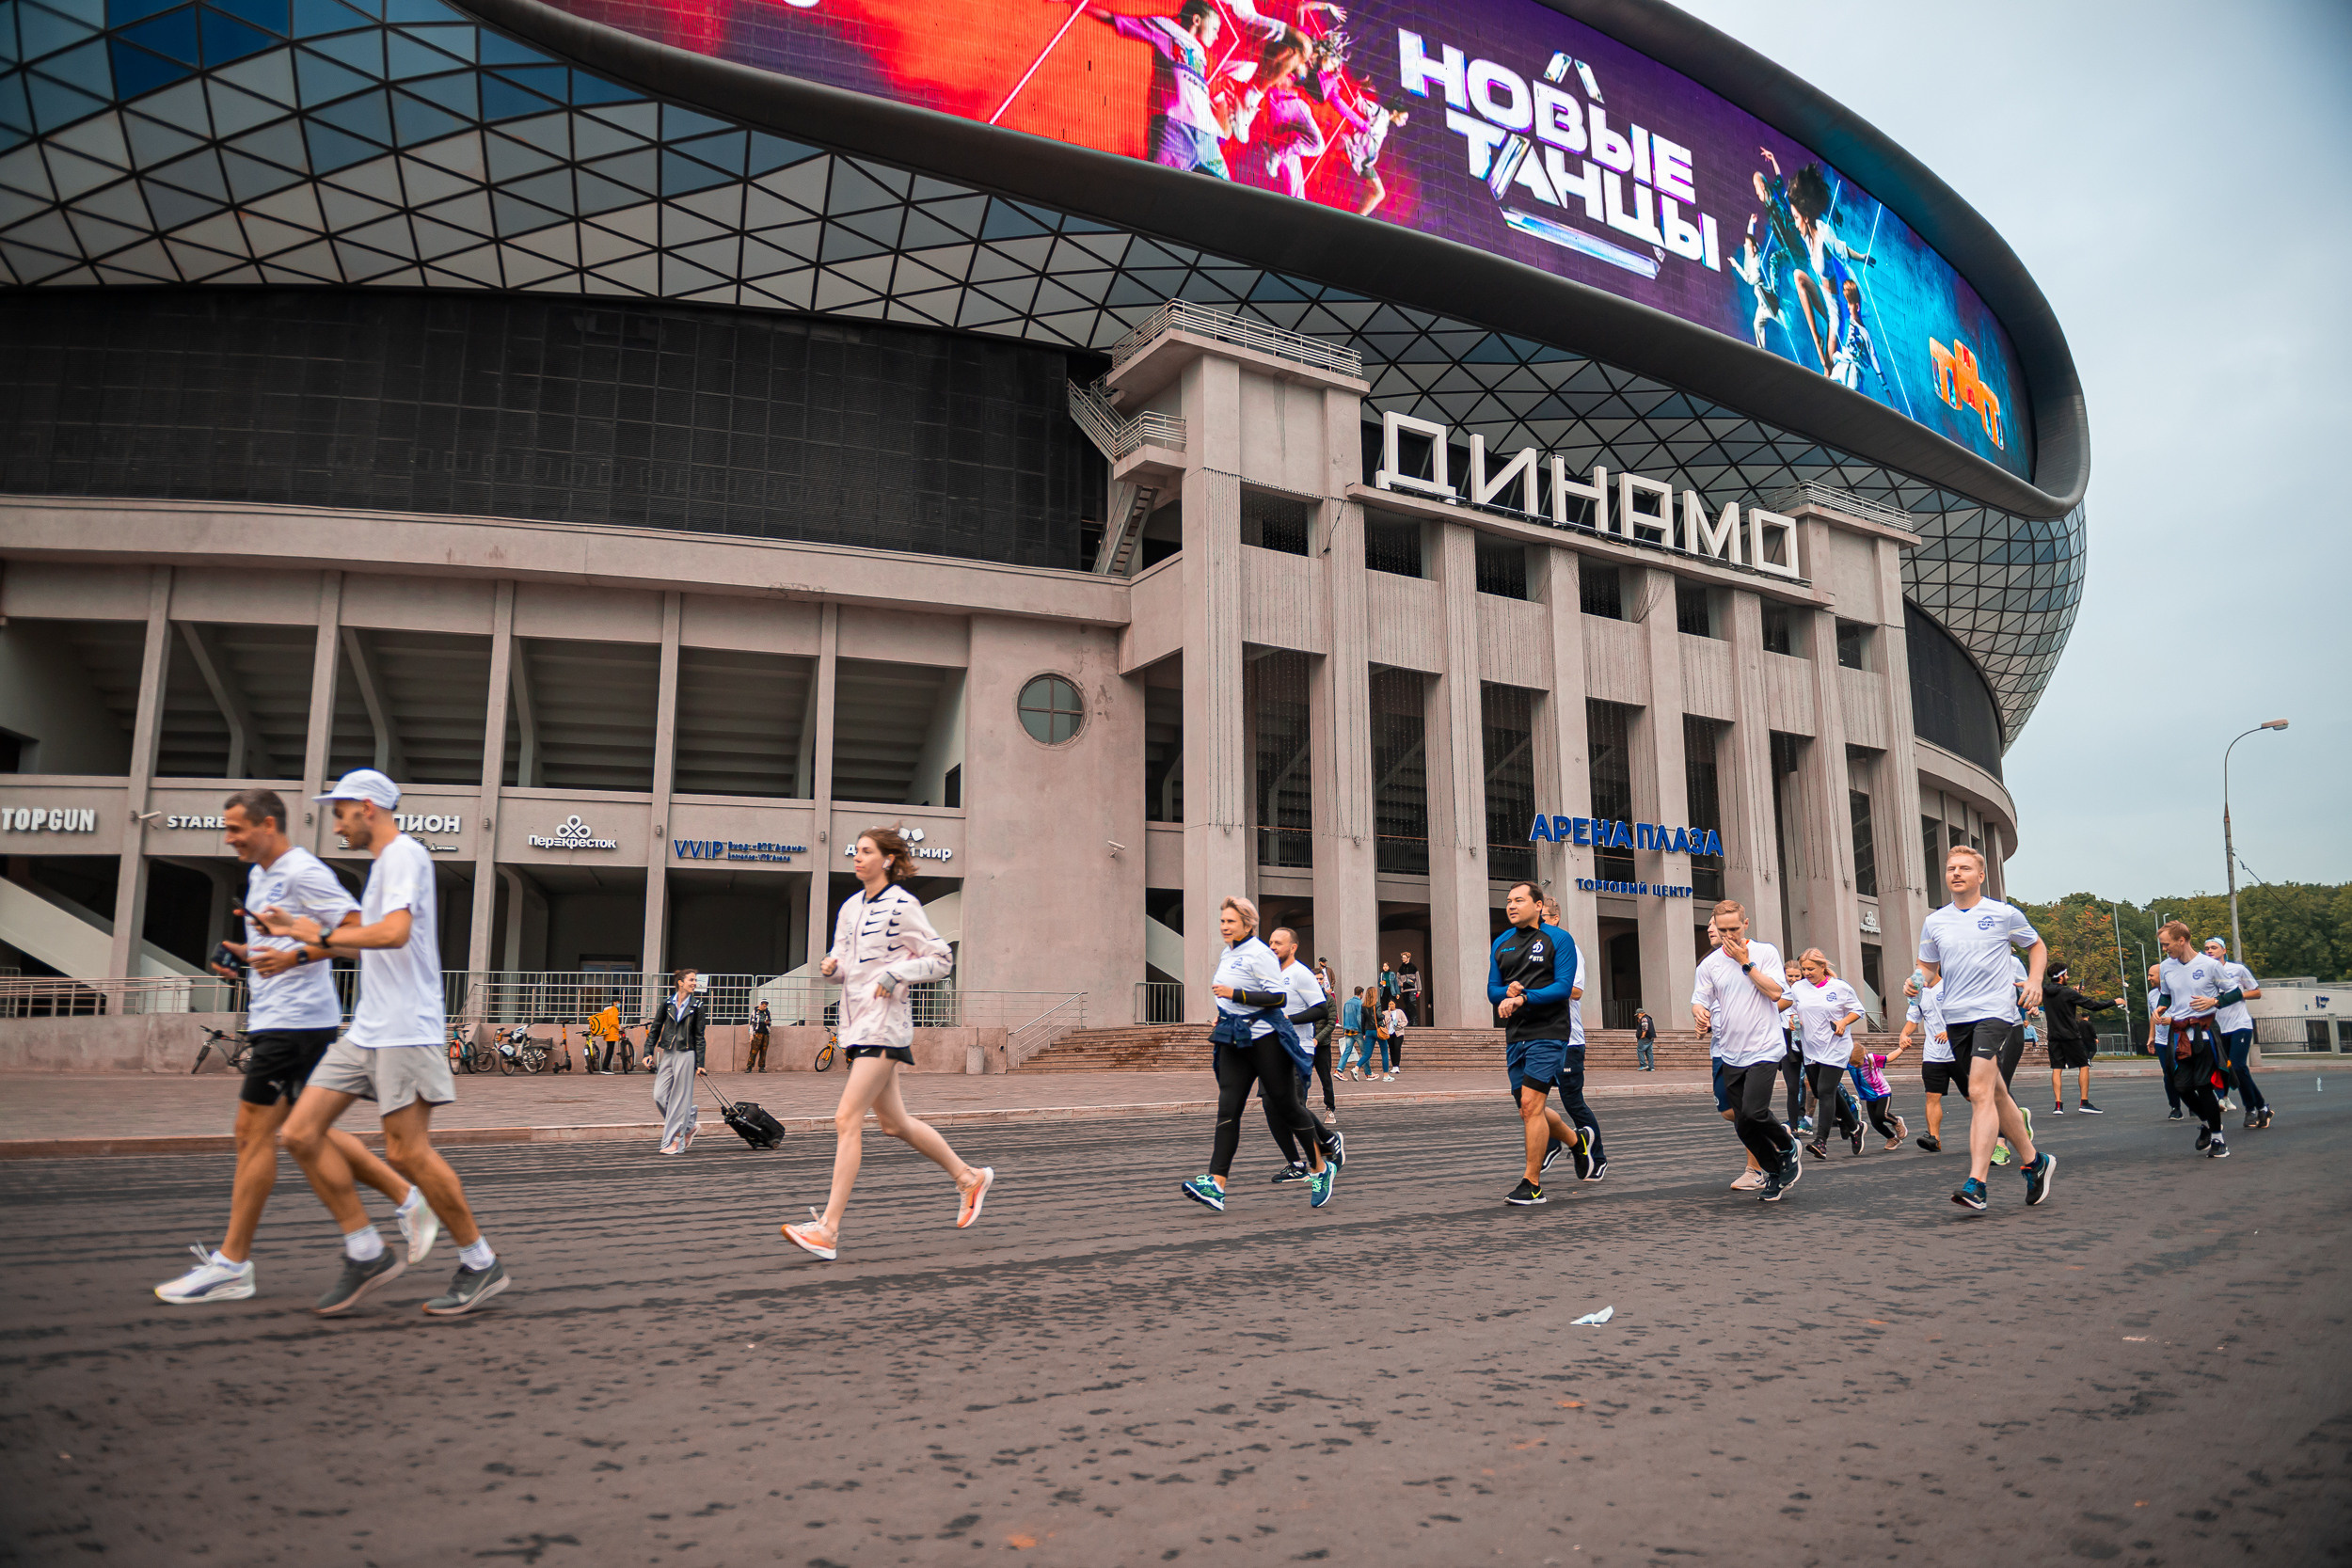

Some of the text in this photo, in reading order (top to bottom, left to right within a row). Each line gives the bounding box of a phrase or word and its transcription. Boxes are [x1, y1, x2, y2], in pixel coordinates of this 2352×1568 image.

[1398, 27, 1695, 205] НОВЫЕ
[1445, 107, 1721, 272] ТАНЦЫ
[1930, 337, 2004, 450] ТНТ
[1375, 411, 1800, 579] ДИНАМО
[528, 834, 617, 849] Перекресток
[674, 839, 723, 859] VVIP
[919, 847, 952, 863] мир
[1529, 813, 1724, 857] АРЕНА ПЛАЗА
[1575, 878, 1693, 898] ТОРГОВЫЙ ЦЕНТР
